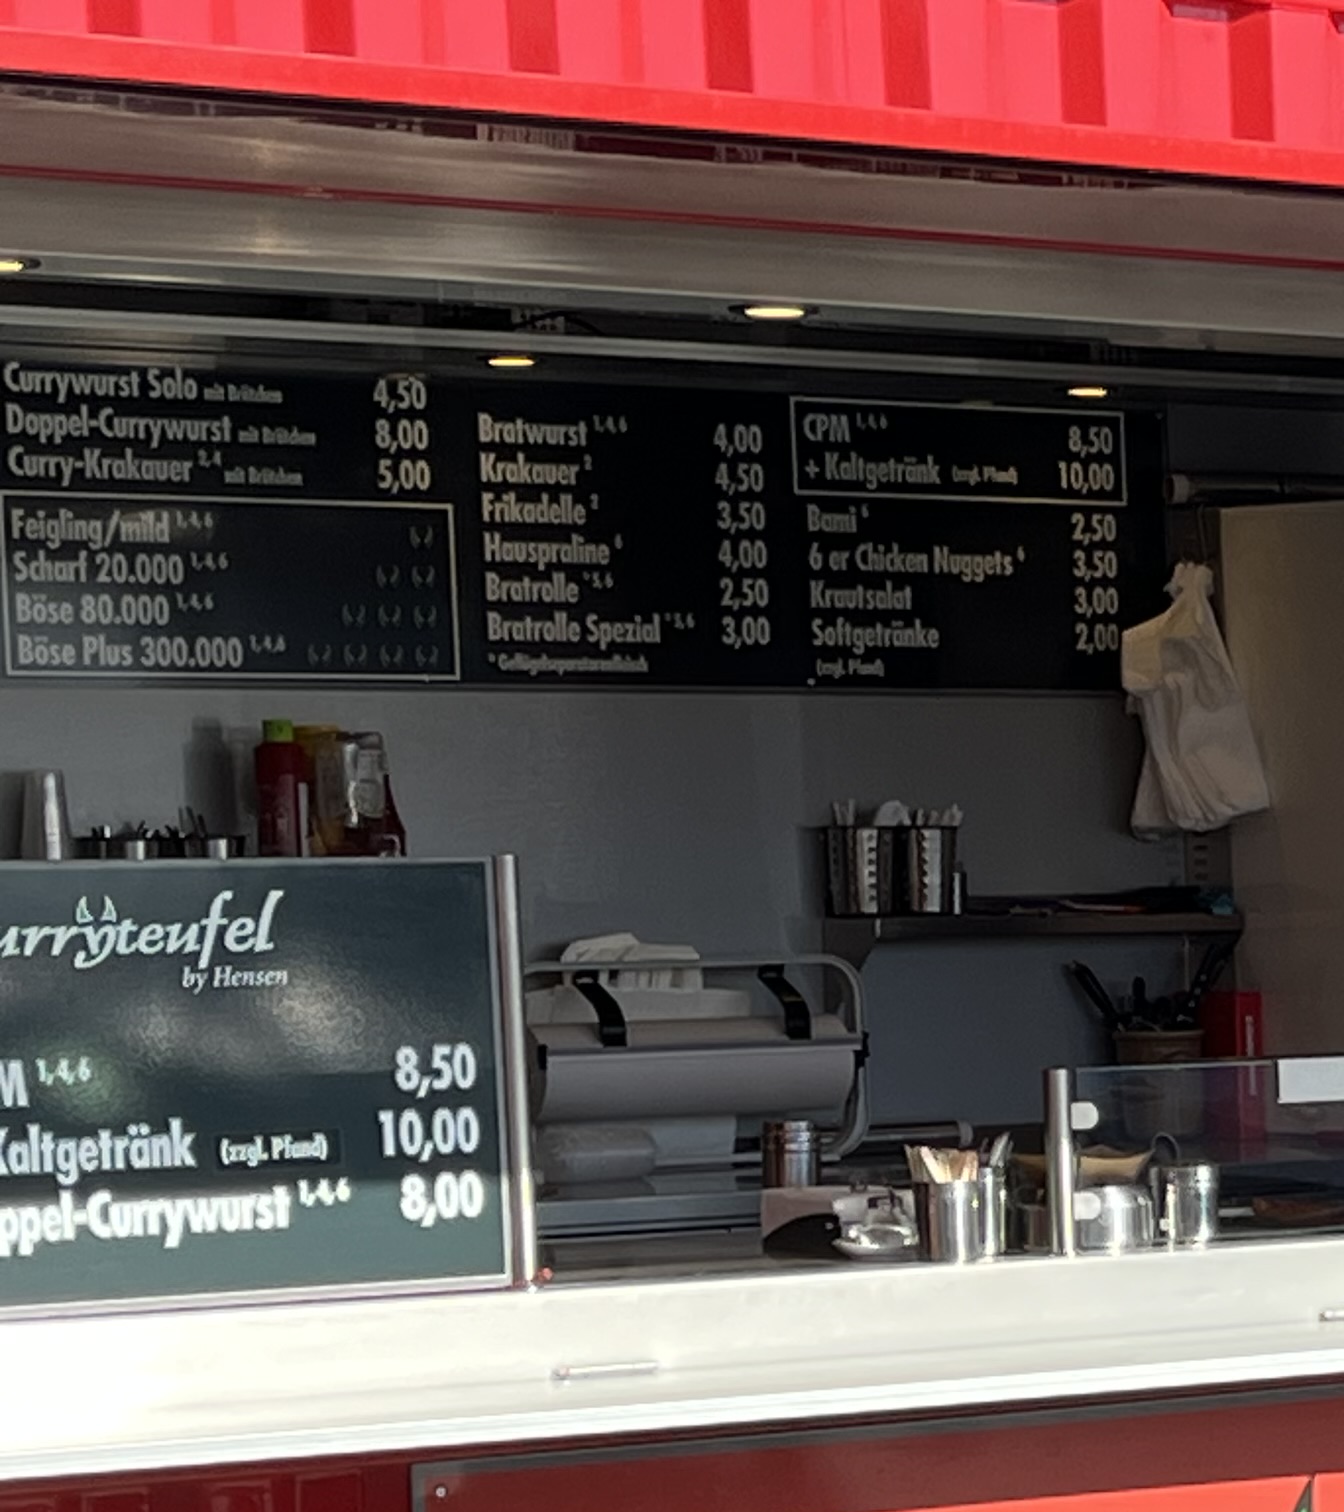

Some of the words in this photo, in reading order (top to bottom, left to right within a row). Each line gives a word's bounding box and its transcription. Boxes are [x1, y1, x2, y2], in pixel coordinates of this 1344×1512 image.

[4, 362, 140, 402] Currywurst
[147, 367, 197, 399] Solo
[373, 377, 427, 413] 4,50
[5, 403, 231, 445] Doppel-Currywurst
[375, 419, 428, 454] 8,00
[478, 412, 588, 447] Bratwurst
[713, 422, 763, 457] 4,00
[803, 413, 851, 443] CPM
[1068, 426, 1113, 456] 8,50
[7, 445, 193, 487] Curry-Krakauer
[377, 459, 431, 495] 5,00
[480, 451, 580, 486] Krakauer
[715, 463, 764, 496] 4,50
[805, 459, 820, 479] +
[825, 452, 941, 490] Kaltgetränk
[1057, 461, 1115, 494] 10,00
[11, 508, 170, 549] Feigling/mild
[481, 492, 587, 525] Frikadelle
[717, 501, 766, 535] 3,50
[807, 504, 857, 533] Bami
[1071, 513, 1117, 545] 2,50
[13, 551, 87, 584] Scharf
[95, 553, 184, 584] 20.000
[483, 531, 611, 571] Hauspraline
[718, 539, 768, 573] 4,00
[808, 542, 823, 571] 6
[828, 551, 849, 571] er
[854, 542, 928, 574] Chicken
[933, 546, 1013, 583] Nuggets
[1073, 550, 1117, 582] 3,50
[15, 593, 73, 625] Böse
[81, 594, 169, 626] 80.000
[485, 571, 579, 604] Bratrolle
[719, 578, 769, 611] 2,50
[810, 580, 913, 610] Krautsalat
[1074, 587, 1119, 618] 3,00
[17, 636, 76, 666] Böse
[82, 636, 133, 666] Plus
[139, 636, 244, 668] 300.000
[486, 611, 581, 643] Bratrolle
[585, 613, 661, 651] Spezial
[721, 616, 770, 649] 3,00
[811, 617, 940, 655] Softgetränke
[1075, 623, 1119, 655] 2,00
[182, 966, 208, 995] by
[213, 965, 288, 988] Hensen
[395, 1043, 476, 1098] 8,50
[377, 1107, 479, 1164] 10,00
[400, 1170, 484, 1227] 8,00
